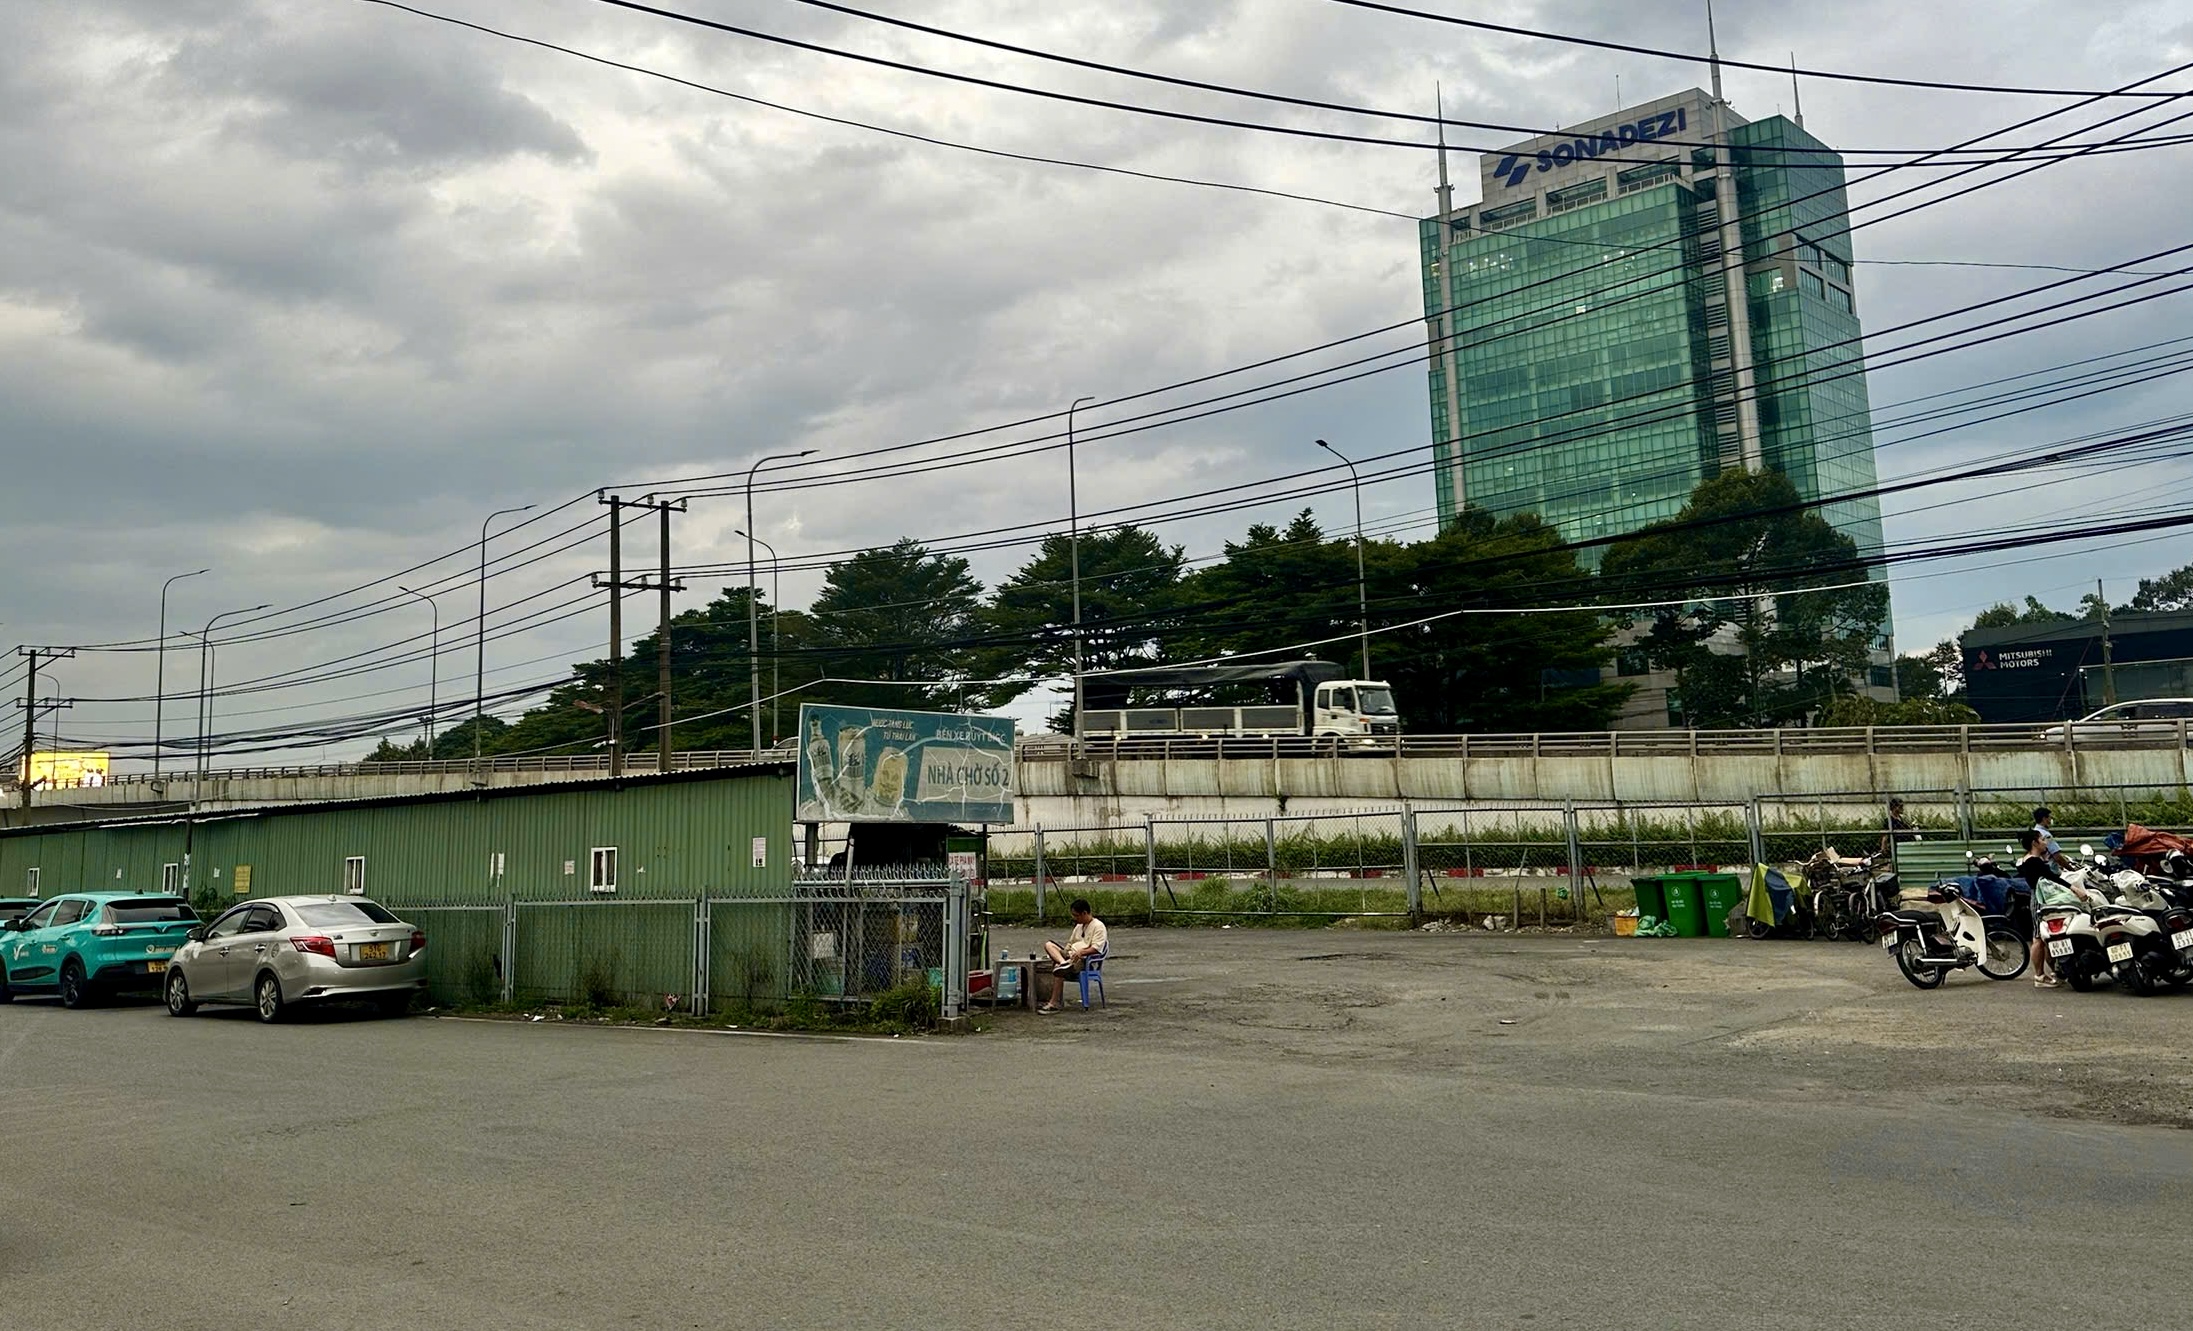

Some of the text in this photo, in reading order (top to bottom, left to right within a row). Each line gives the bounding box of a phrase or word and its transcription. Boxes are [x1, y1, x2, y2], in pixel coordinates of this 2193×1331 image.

[1536, 107, 1686, 173] SONADEZI
[2000, 659, 2039, 668] MOTORS
[928, 761, 1009, 786] NHÀ CHỜ SỐ 2
